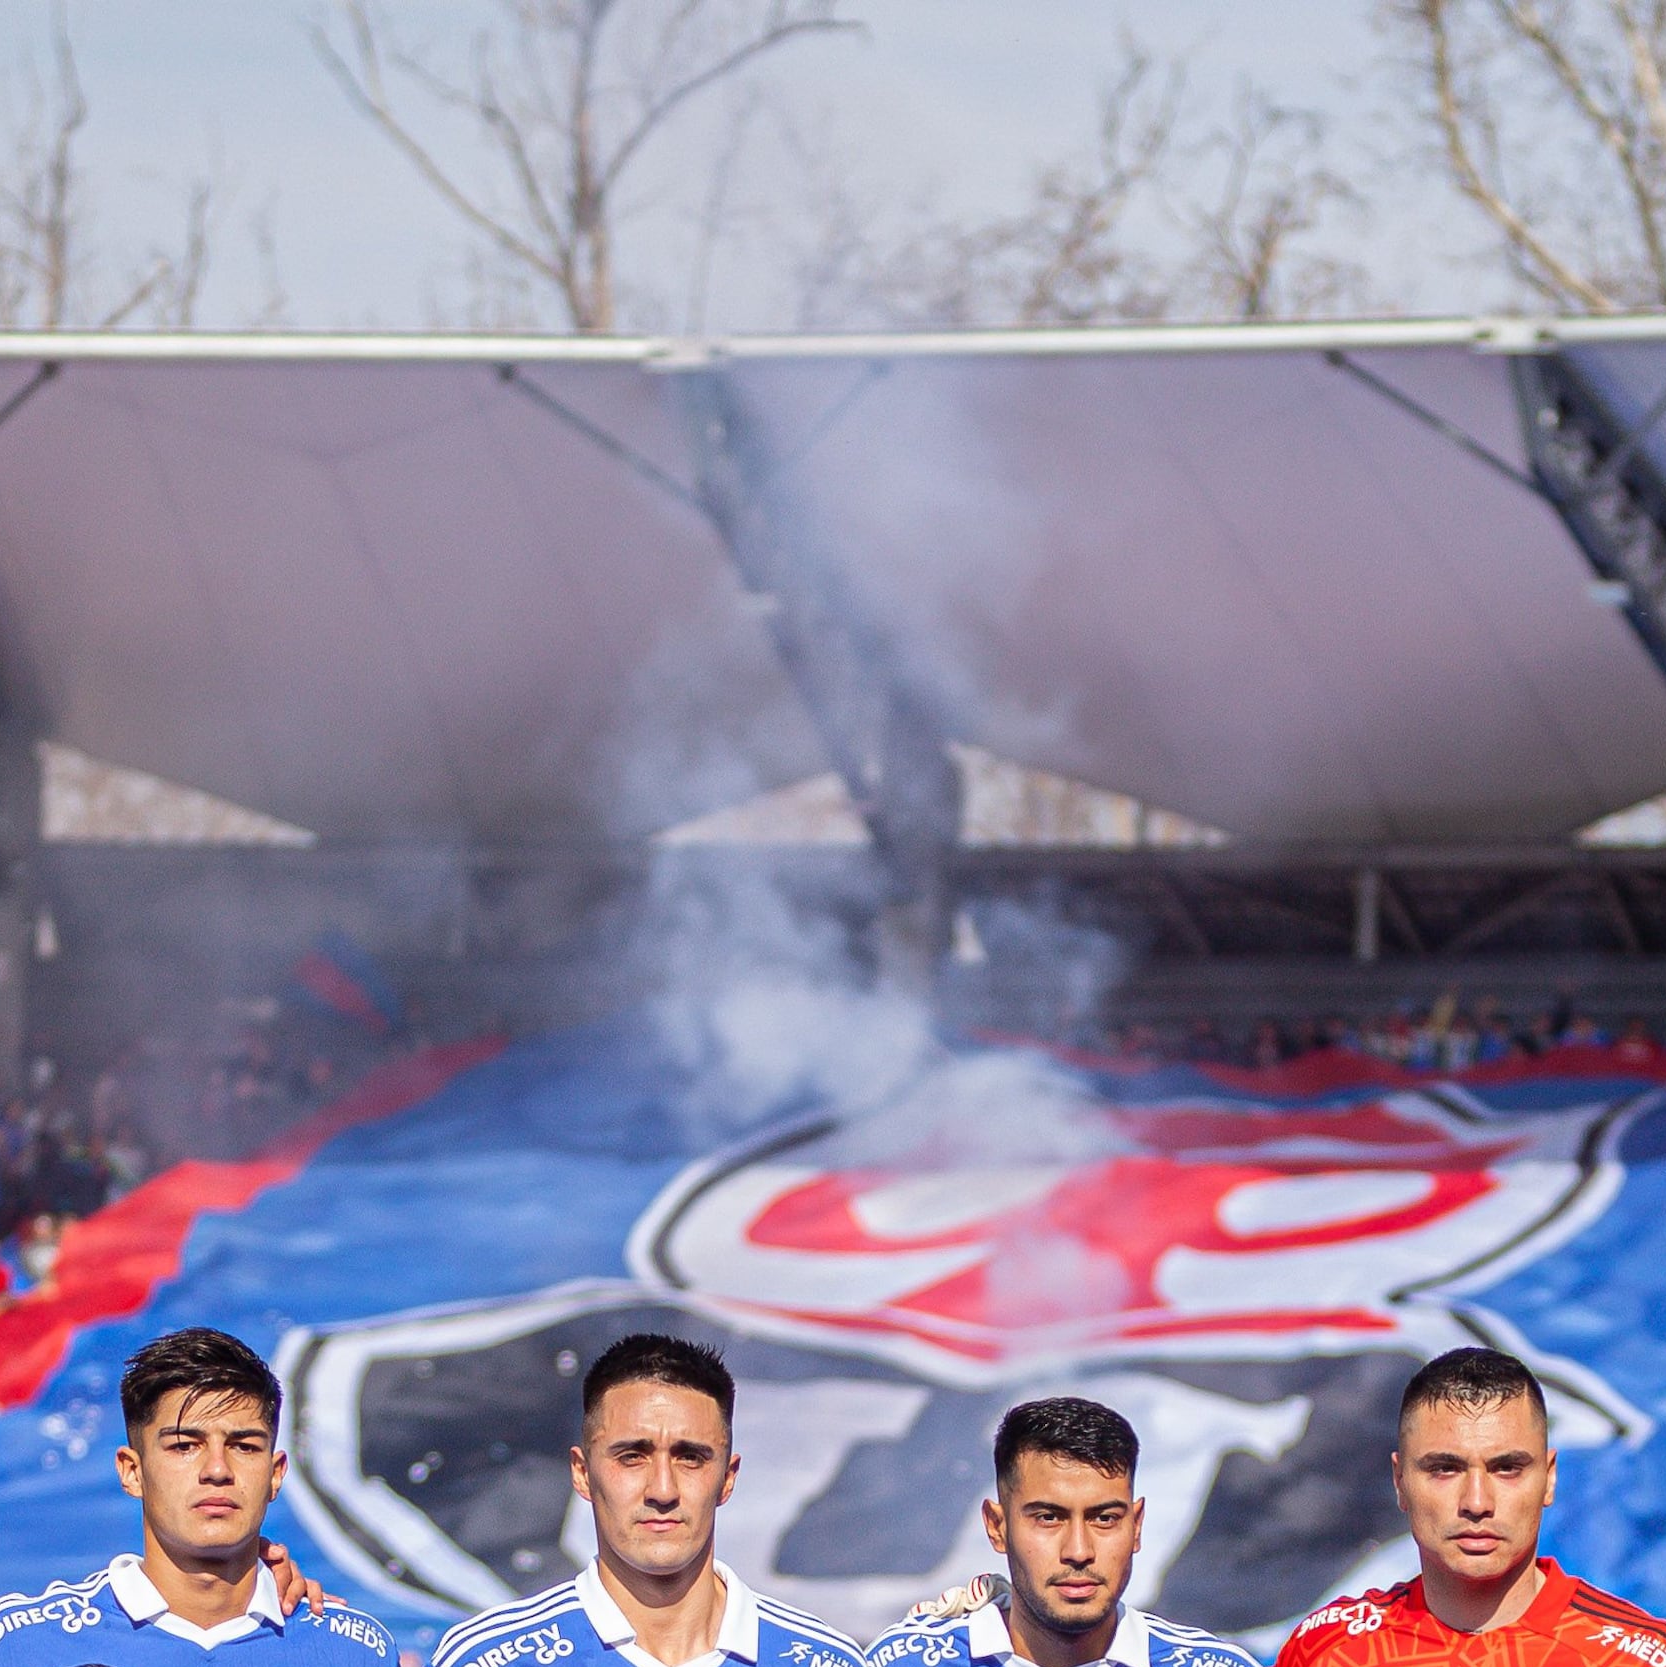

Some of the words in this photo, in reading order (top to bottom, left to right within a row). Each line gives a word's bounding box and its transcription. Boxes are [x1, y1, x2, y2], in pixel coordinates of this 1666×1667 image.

[61, 1607, 102, 1634] GO
[1347, 1613, 1383, 1636] GO
[329, 1617, 388, 1659] MEDS
[536, 1638, 574, 1666] GO
[923, 1636, 960, 1667] GO
